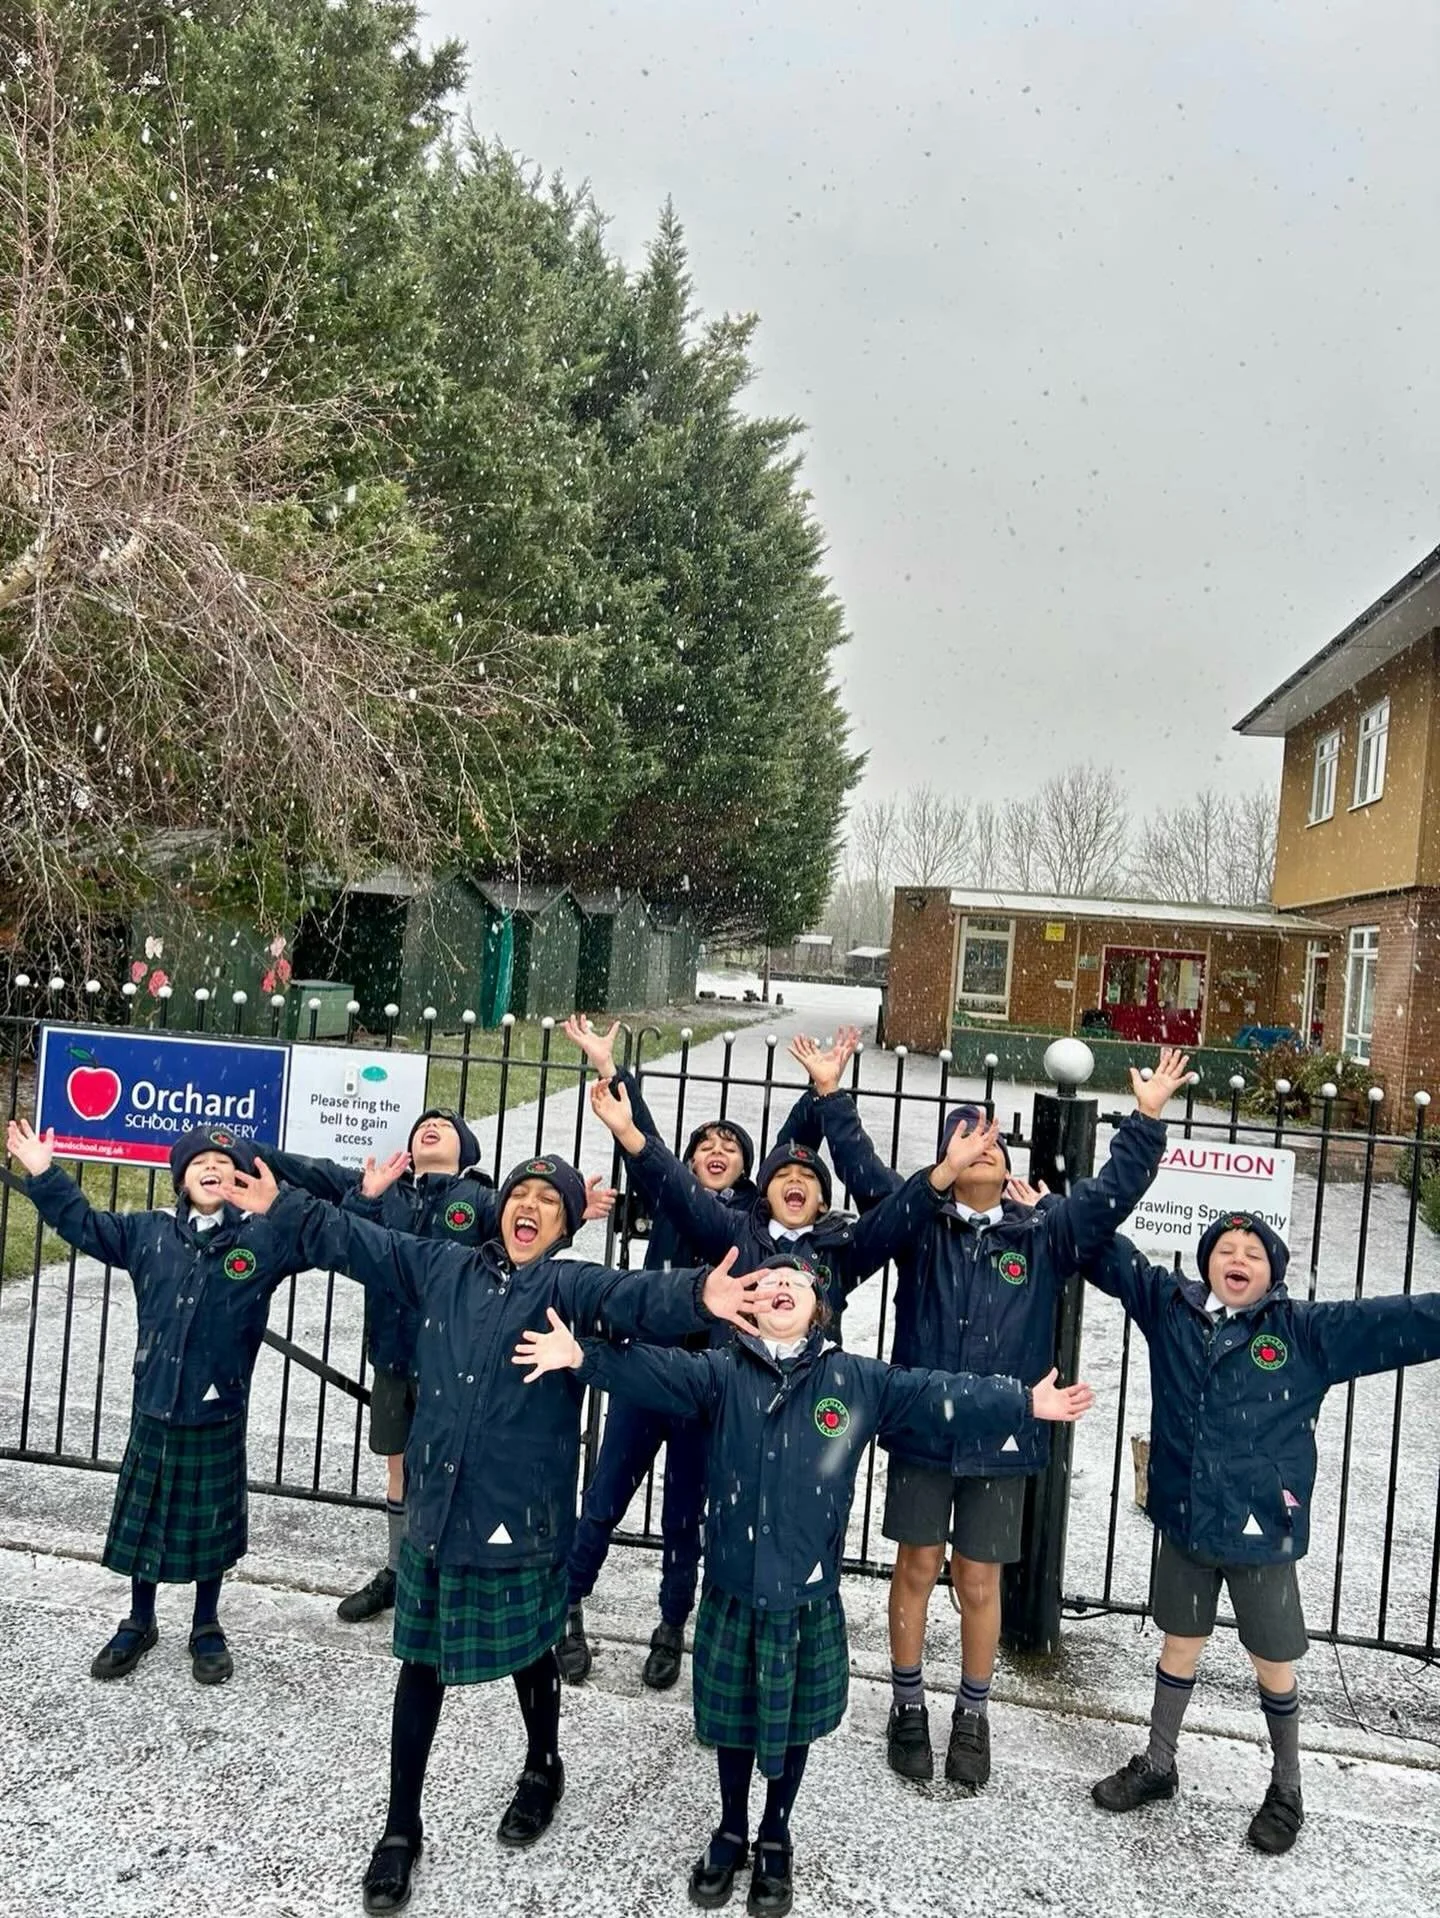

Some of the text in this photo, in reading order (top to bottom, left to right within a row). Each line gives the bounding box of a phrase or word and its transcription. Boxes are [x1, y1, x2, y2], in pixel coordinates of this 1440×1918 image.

[131, 1080, 256, 1119] Orchard
[310, 1093, 401, 1114] Please ring the
[124, 1112, 180, 1132] SCHOOL
[181, 1117, 194, 1133] &
[320, 1111, 388, 1132] bell to gain
[334, 1133, 374, 1147] access
[1135, 1216, 1193, 1236] Beyond
